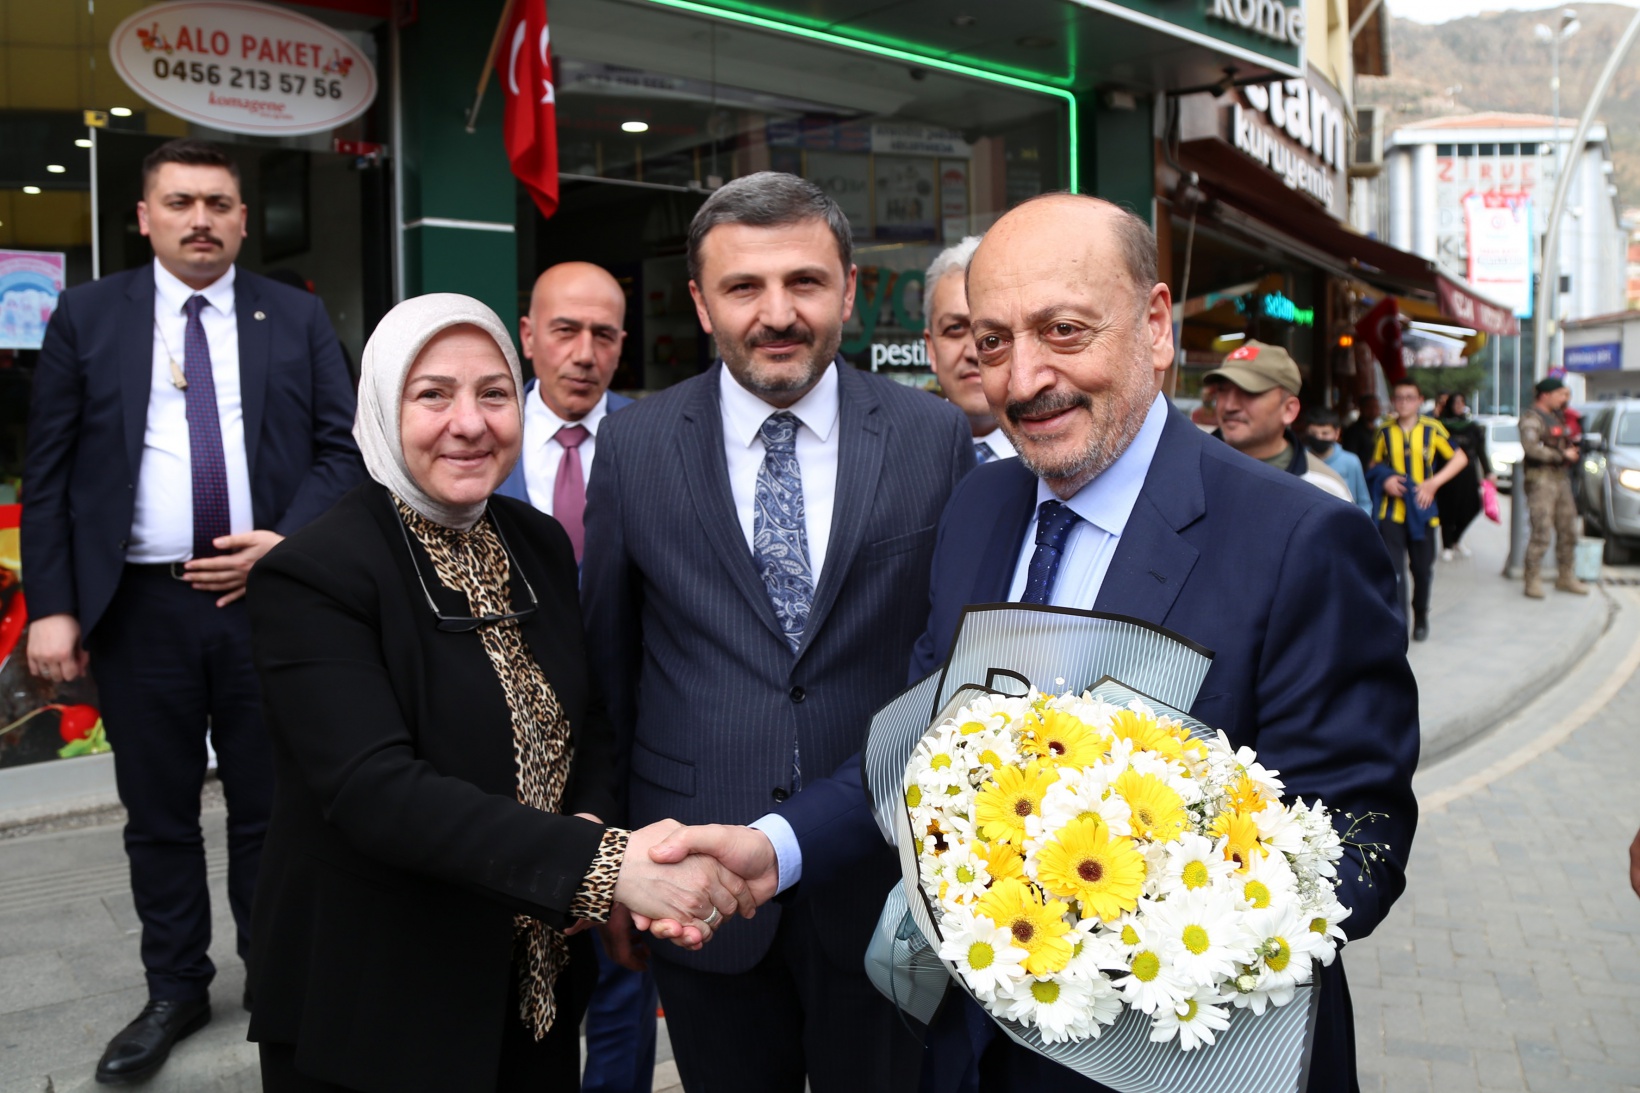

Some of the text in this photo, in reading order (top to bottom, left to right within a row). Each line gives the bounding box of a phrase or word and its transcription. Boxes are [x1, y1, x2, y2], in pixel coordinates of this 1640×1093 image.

[175, 26, 322, 69] ALO PAKET
[153, 57, 342, 99] 0456 213 57 56
[208, 90, 287, 113] komagene
